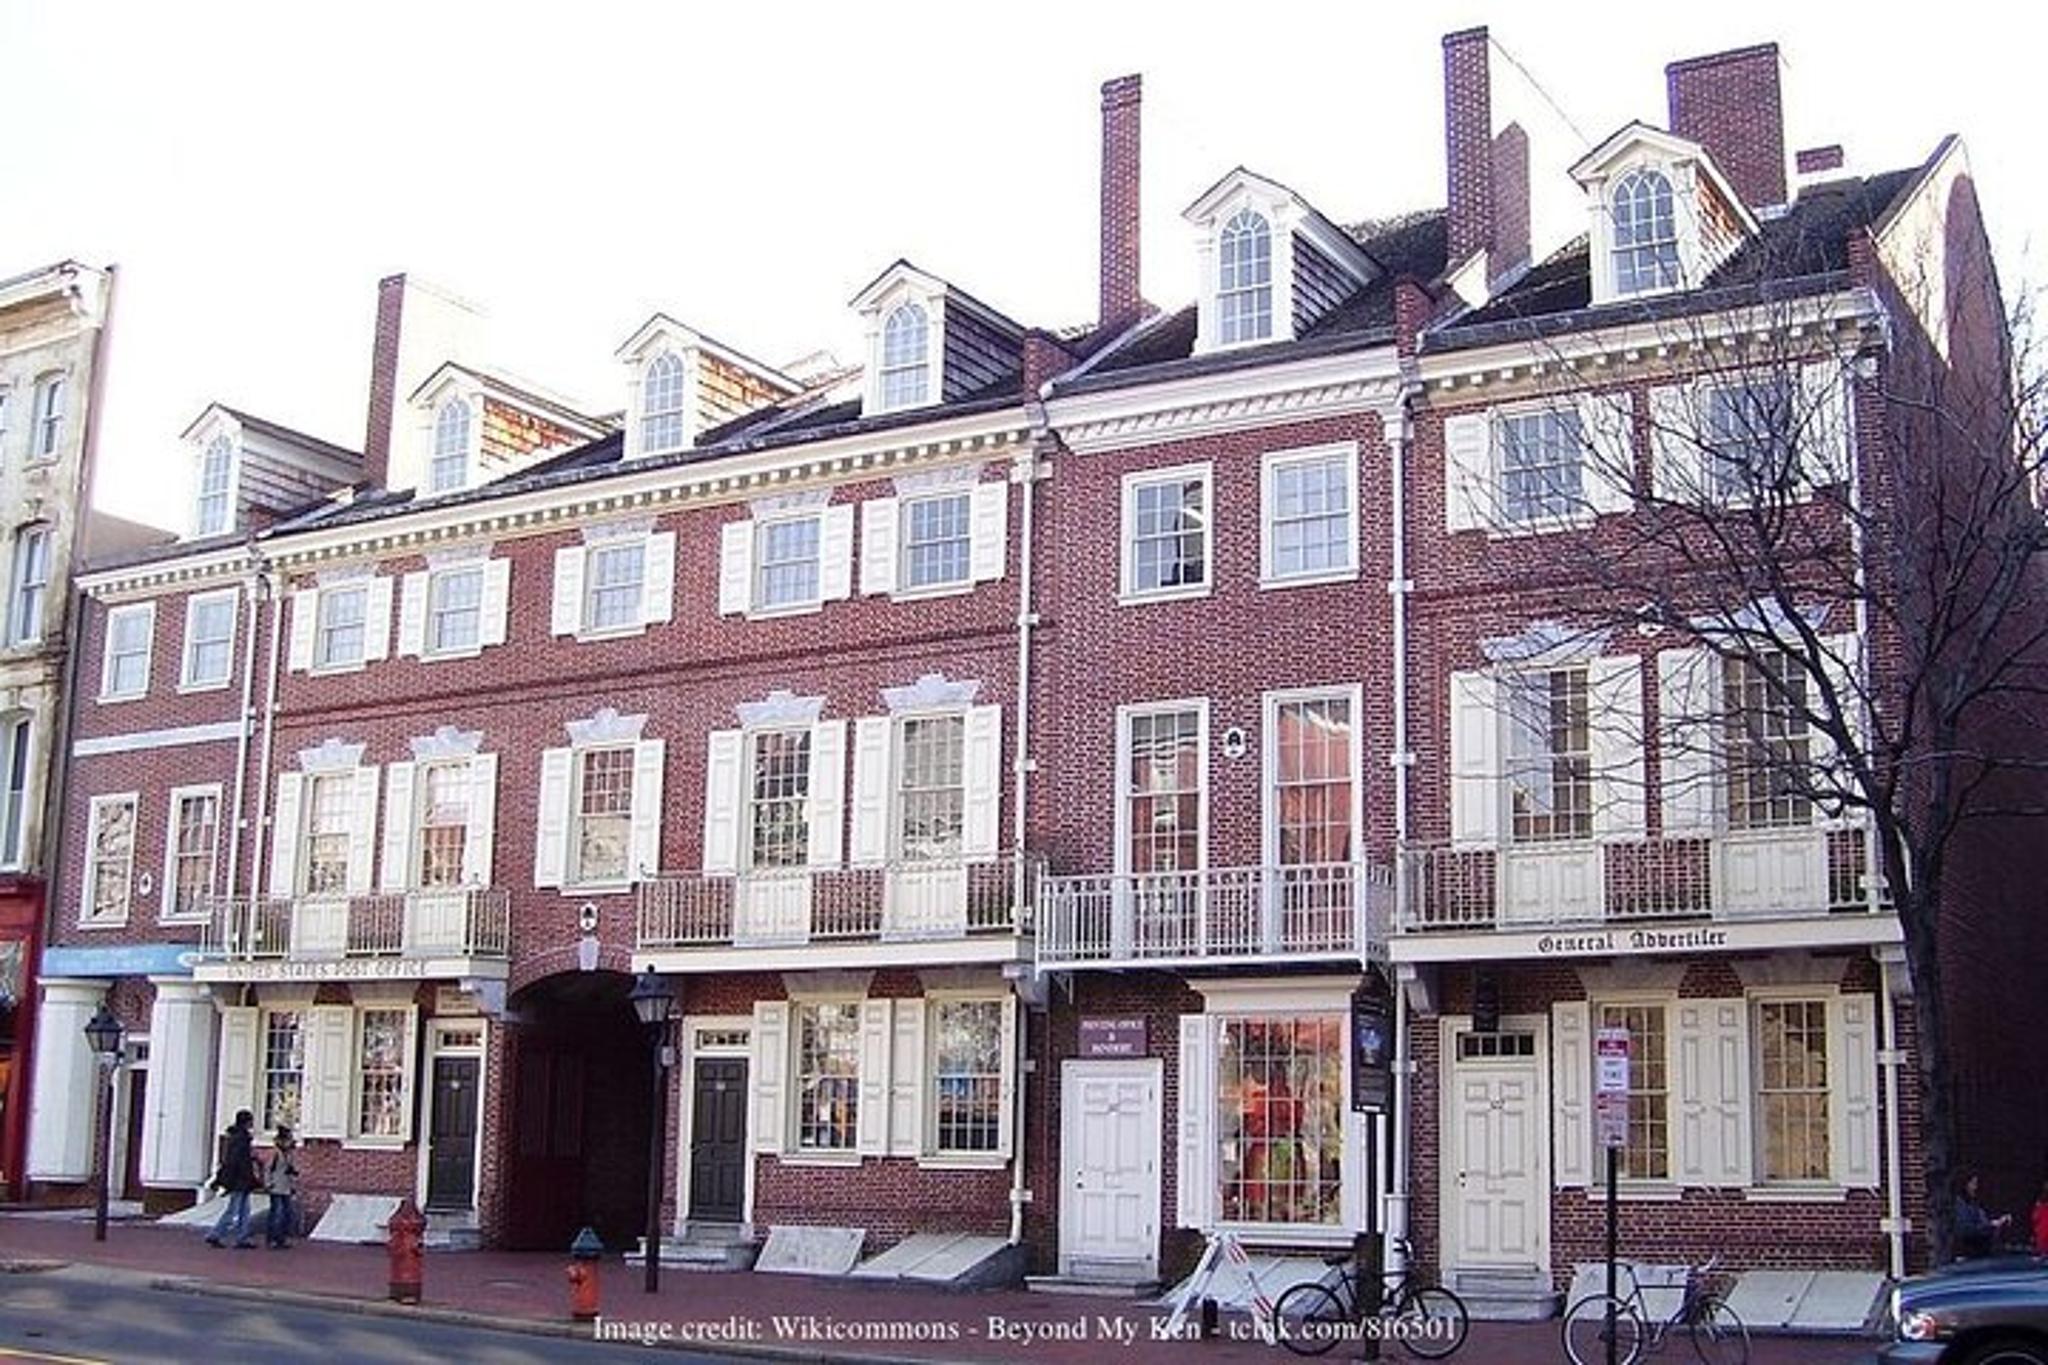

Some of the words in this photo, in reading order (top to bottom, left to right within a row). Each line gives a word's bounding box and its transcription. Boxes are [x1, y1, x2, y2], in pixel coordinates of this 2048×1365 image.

[1538, 932, 1614, 953] General
[280, 961, 330, 978] STATES
[335, 959, 370, 976] POST
[375, 957, 427, 976] OFFICE
